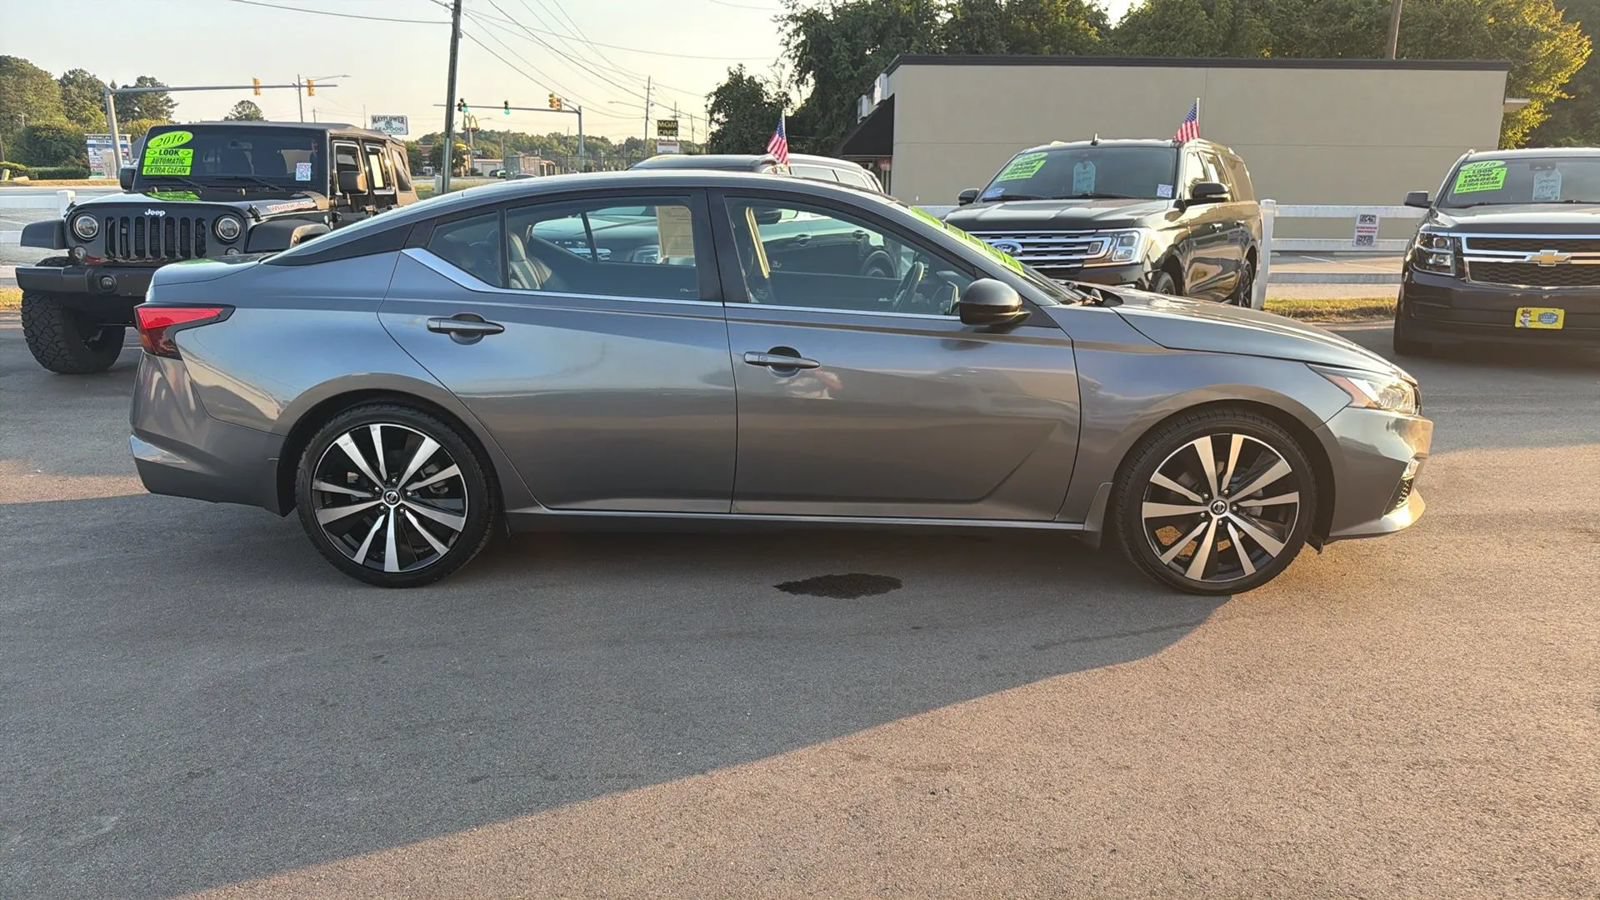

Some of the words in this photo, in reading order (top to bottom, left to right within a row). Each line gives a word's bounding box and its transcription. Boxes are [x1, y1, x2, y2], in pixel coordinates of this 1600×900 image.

[156, 135, 185, 148] 2016
[150, 157, 186, 165] AUTOMATIC
[144, 208, 165, 216] Jeep
